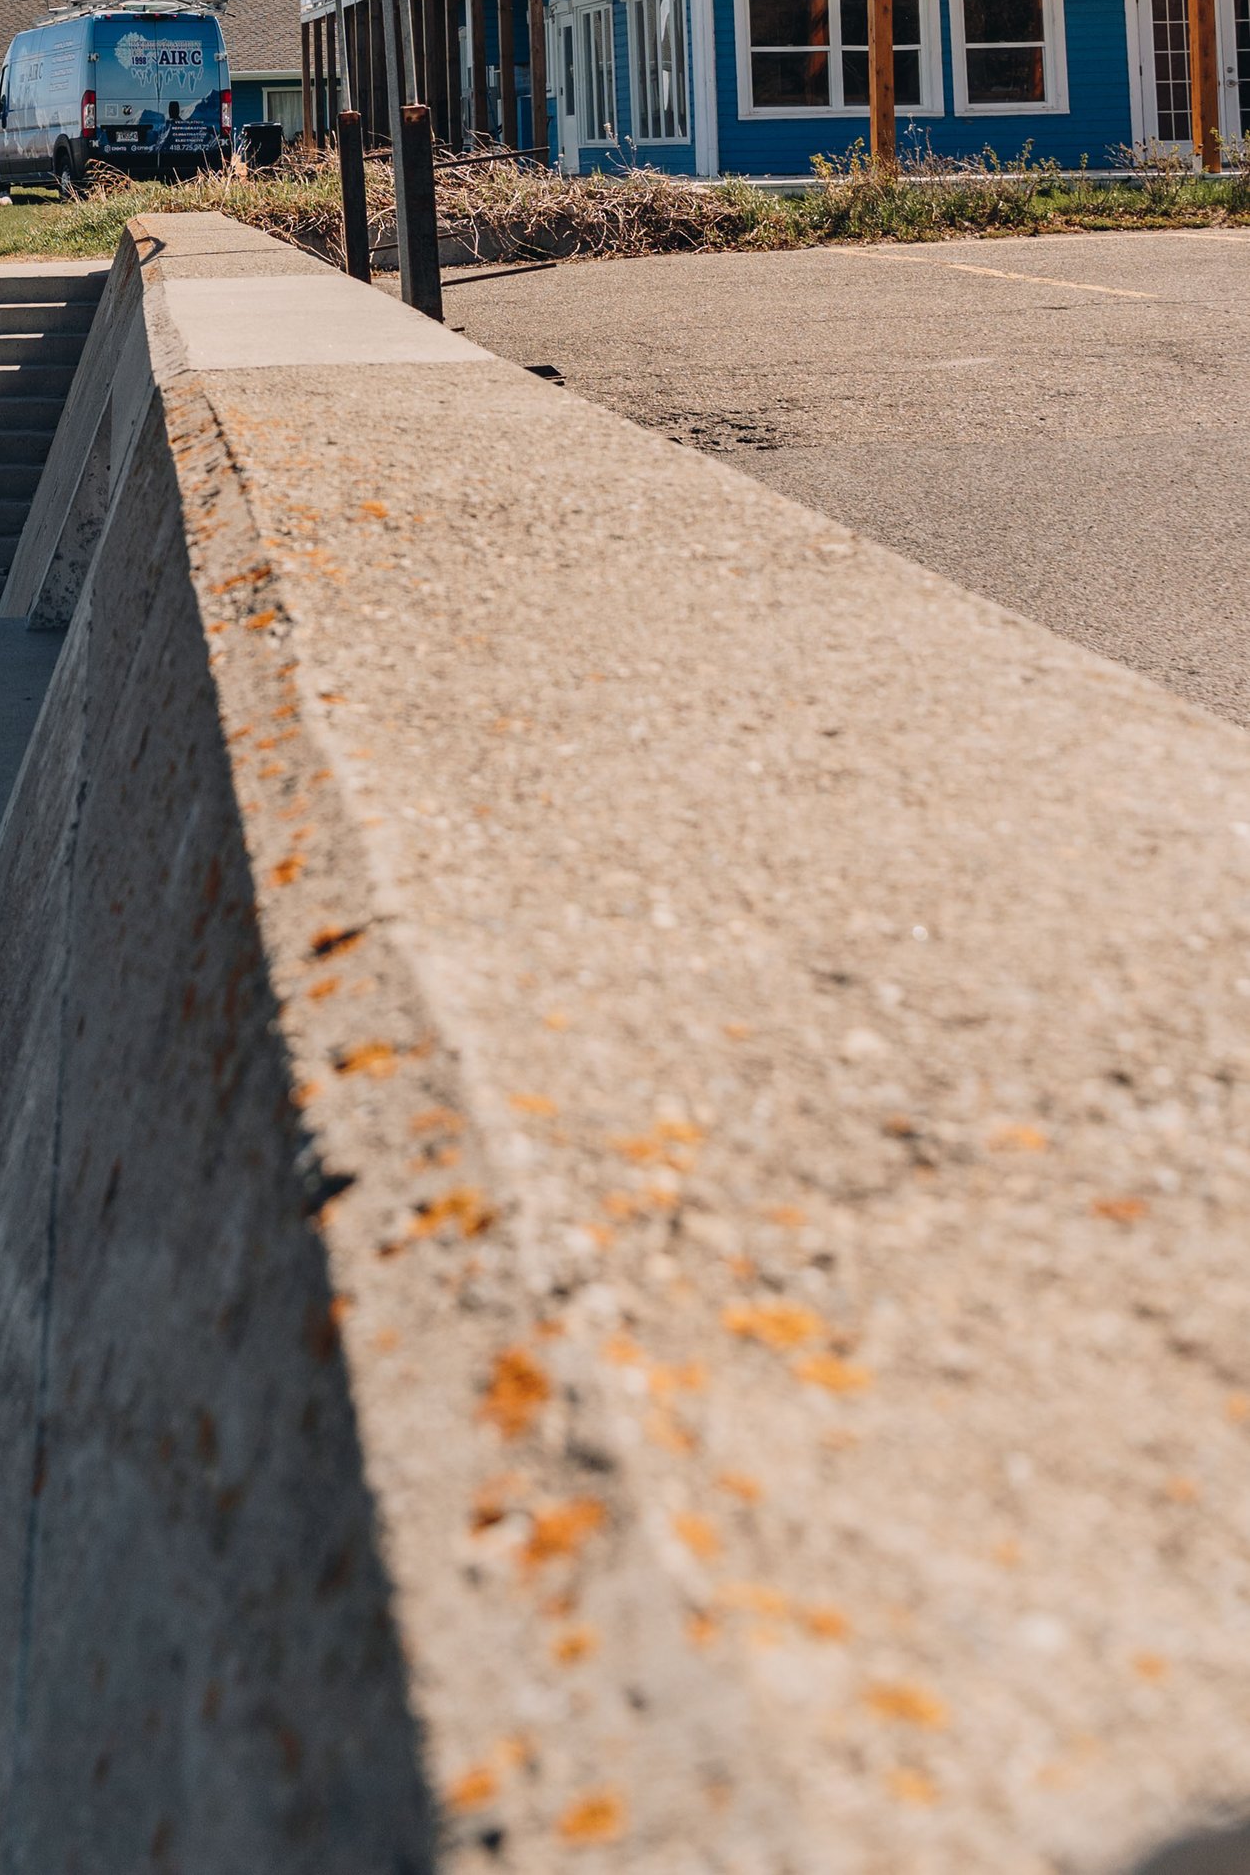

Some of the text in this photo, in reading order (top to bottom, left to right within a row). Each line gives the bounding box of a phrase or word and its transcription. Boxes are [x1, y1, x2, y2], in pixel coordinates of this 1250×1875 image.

[131, 56, 147, 65] 1998
[159, 50, 188, 65] AIR
[191, 50, 202, 65] C
